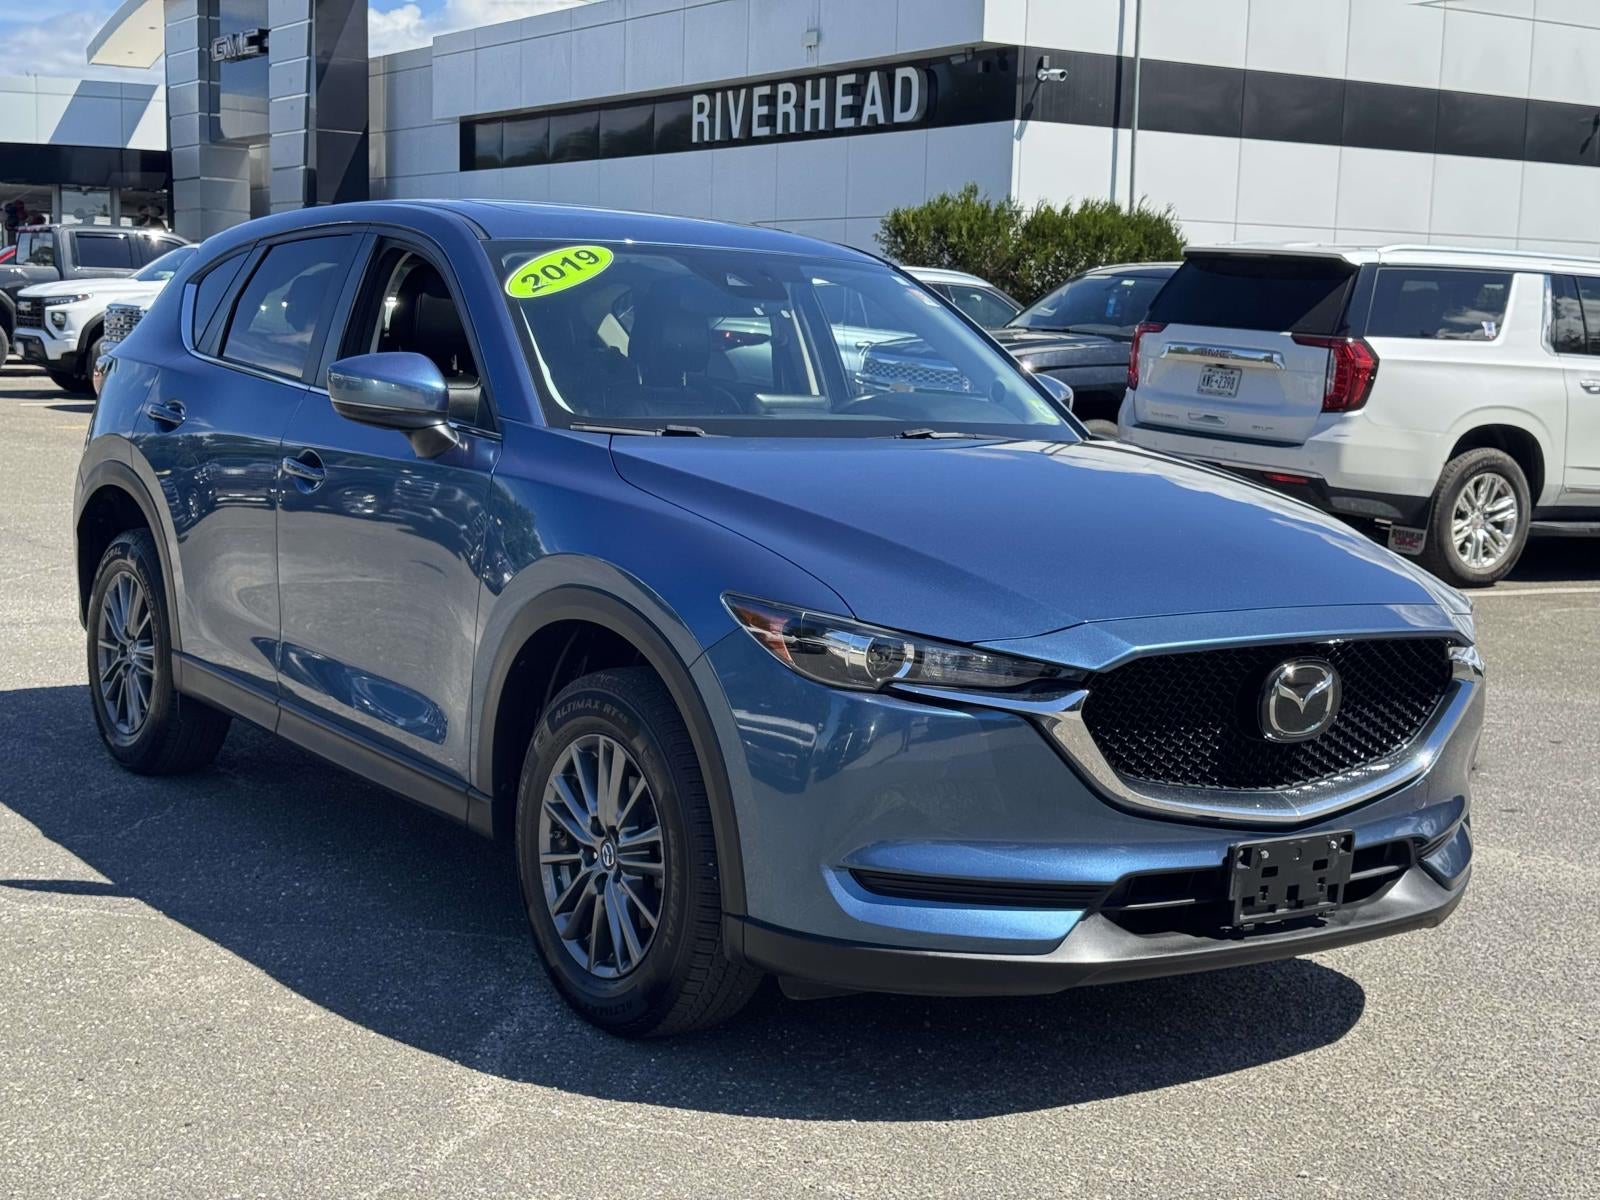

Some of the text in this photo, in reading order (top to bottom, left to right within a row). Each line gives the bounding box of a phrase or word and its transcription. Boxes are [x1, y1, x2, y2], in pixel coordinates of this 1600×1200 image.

[211, 28, 259, 62] GMC
[691, 65, 922, 144] RIVERHEAD
[520, 249, 600, 293] 2019
[554, 698, 601, 723] ALTIMAX
